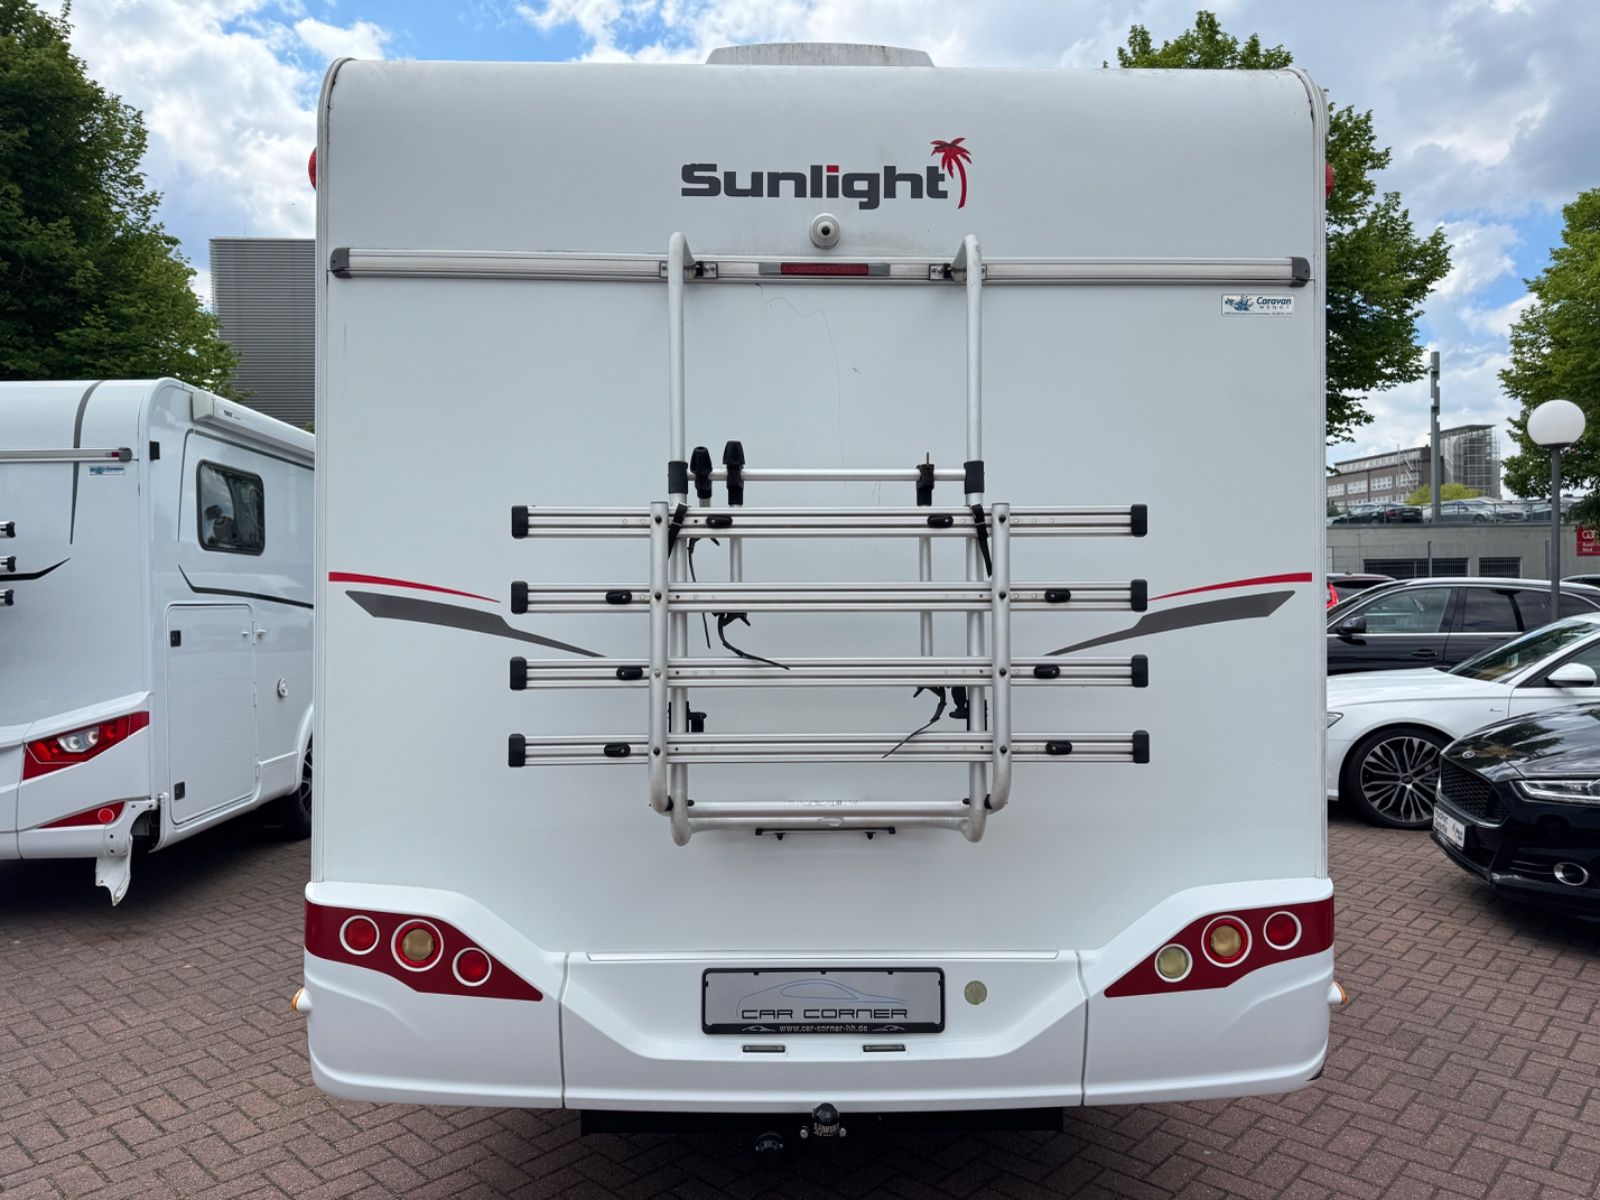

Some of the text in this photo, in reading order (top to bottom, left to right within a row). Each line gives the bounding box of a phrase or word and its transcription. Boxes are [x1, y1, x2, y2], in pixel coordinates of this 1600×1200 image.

[681, 163, 949, 211] Sunlight
[1256, 296, 1292, 305] Caravan
[741, 1008, 908, 1020] CAR CORNER
